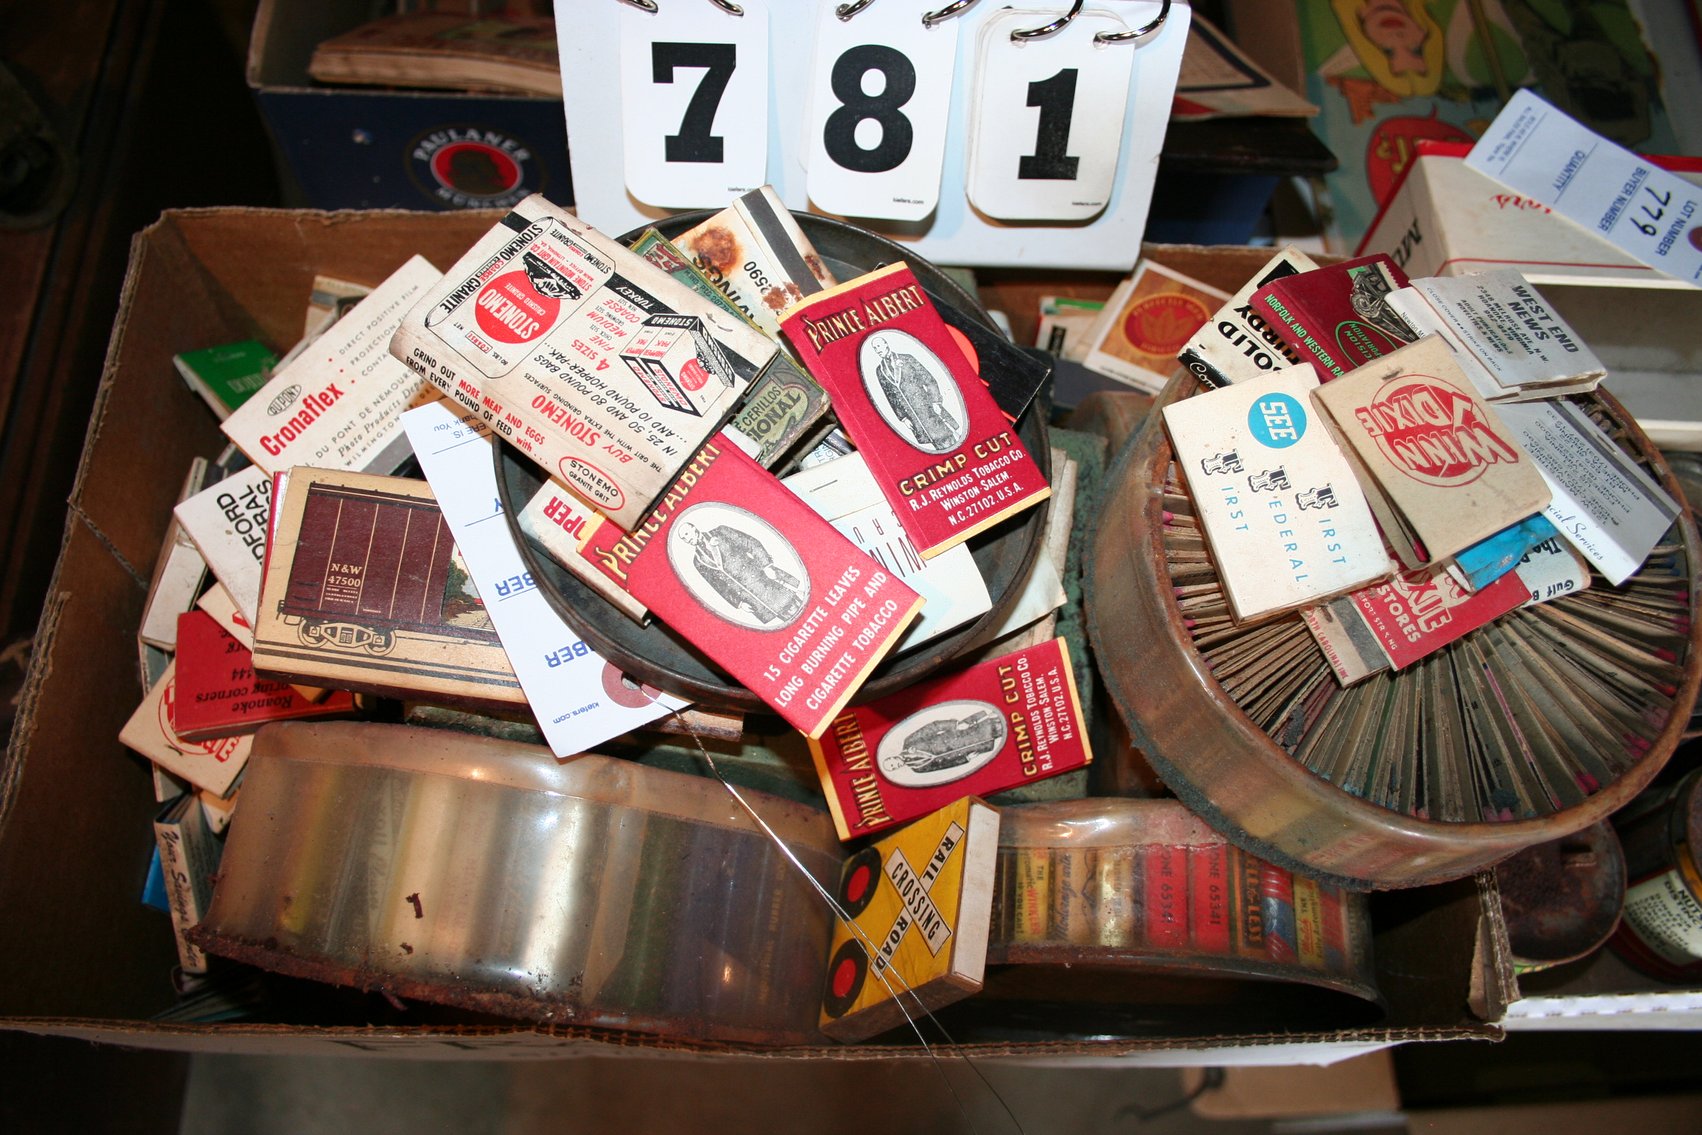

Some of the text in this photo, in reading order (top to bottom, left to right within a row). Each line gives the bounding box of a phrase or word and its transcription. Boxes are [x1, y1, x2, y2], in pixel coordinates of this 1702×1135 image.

[651, 41, 1081, 181] 7 8 1
[1552, 150, 1586, 191] QUANTITY
[1597, 166, 1648, 231] BUYER NUMBER
[499, 223, 544, 262] STONEMO
[1655, 199, 1699, 256] LOT NUMBER
[440, 277, 482, 314] GRANITE
[478, 288, 540, 340] STONEMO
[602, 299, 640, 324] COARSE
[615, 285, 655, 311] TURKEY
[802, 284, 925, 352] PRINCE ALBERT
[586, 310, 628, 338] MEDIUM
[650, 315, 694, 327] STONEMO
[1264, 293, 1296, 325] NORFOLK
[1290, 322, 1308, 338] AND
[1303, 335, 1336, 369] WESTERN
[1507, 300, 1551, 342] NEWS
[1511, 285, 1579, 354] WEST END
[534, 353, 562, 375] BAGS
[570, 339, 610, 371] 4 SIZES
[588, 335, 615, 352] FINE
[405, 355, 427, 376] FROM
[453, 388, 481, 413] POUND
[482, 408, 494, 423] OF
[495, 418, 513, 437] FEED
[516, 434, 534, 454] with
[413, 347, 546, 446] GRIND OUT MORE MEAT AND EGGS
[559, 371, 592, 396] POUND
[590, 393, 608, 406] 80
[605, 388, 642, 415] POUND
[260, 382, 345, 457] Cronaflex
[531, 394, 634, 465] BUY STONEMO
[606, 404, 630, 422] AND
[628, 421, 646, 435] 50
[1258, 401, 1298, 441] SEE
[1355, 384, 1454, 438] DIXIE
[661, 445, 678, 457] IN
[898, 431, 1012, 496] CRIMP CUT
[1393, 418, 1519, 470] WINN
[568, 470, 610, 504] GRANITE GRIT
[569, 459, 619, 498] STONEMO
[928, 472, 974, 502] REYNOLDS
[971, 454, 1012, 478] TOBACCO
[1566, 522, 1605, 562] Services
[328, 575, 361, 588] 47500
[1547, 579, 1575, 598] Gulf
[763, 565, 861, 683] 15 CIGARETTE LEAVES
[1376, 584, 1422, 643] STORES
[774, 675, 805, 708] LONG
[800, 625, 845, 675] BURNING
[841, 597, 867, 625] PIPE
[863, 571, 887, 599] AND
[805, 651, 857, 711] CIGARETTE
[851, 599, 898, 652] TOBACCO
[1020, 671, 1038, 712] TOBACCO
[999, 665, 1039, 778] CRIMP CUT
[1029, 708, 1050, 753] REYNOLDS
[852, 772, 894, 829] PRINCE
[922, 836, 955, 881] RAIL
[891, 862, 940, 941] CROSSING
[875, 915, 909, 970] ROAD
